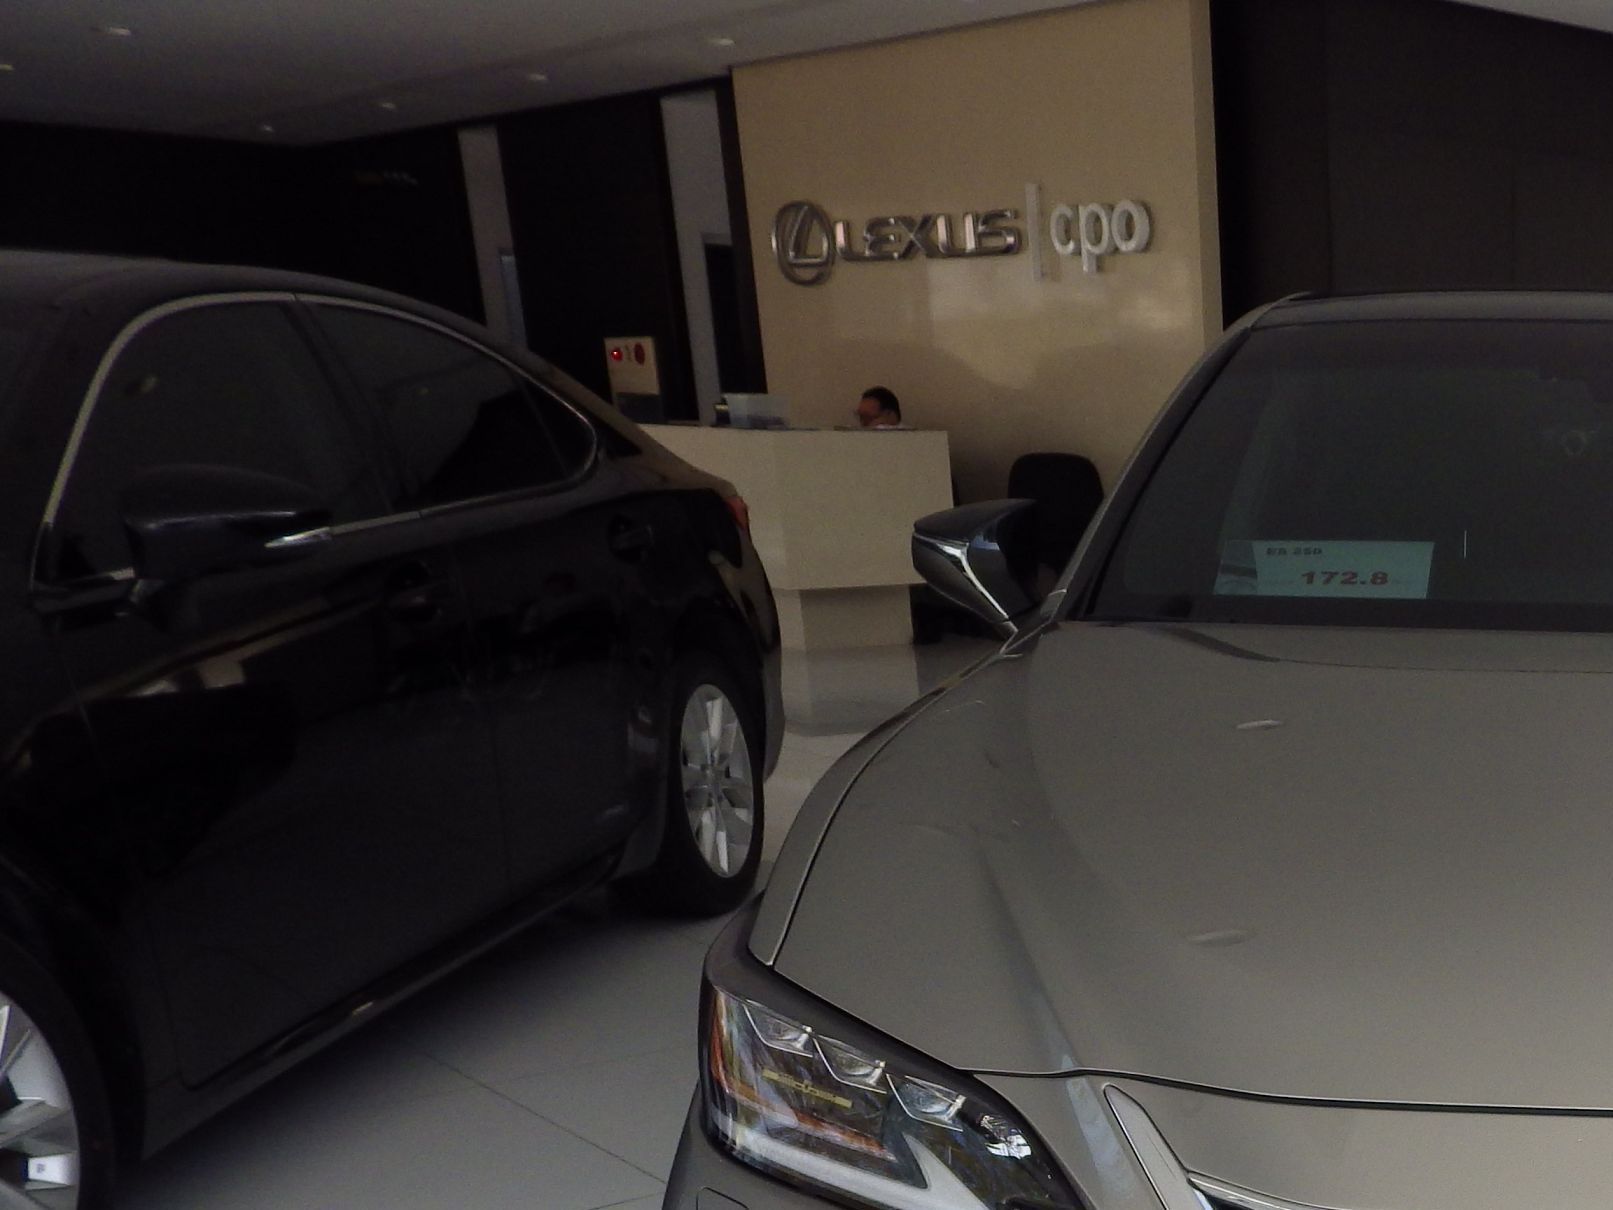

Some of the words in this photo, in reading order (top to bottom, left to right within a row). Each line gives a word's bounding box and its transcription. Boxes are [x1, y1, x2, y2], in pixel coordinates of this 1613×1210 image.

[833, 208, 1022, 262] LEXUS
[1049, 200, 1152, 275] cpo
[1300, 570, 1389, 586] 172.8
